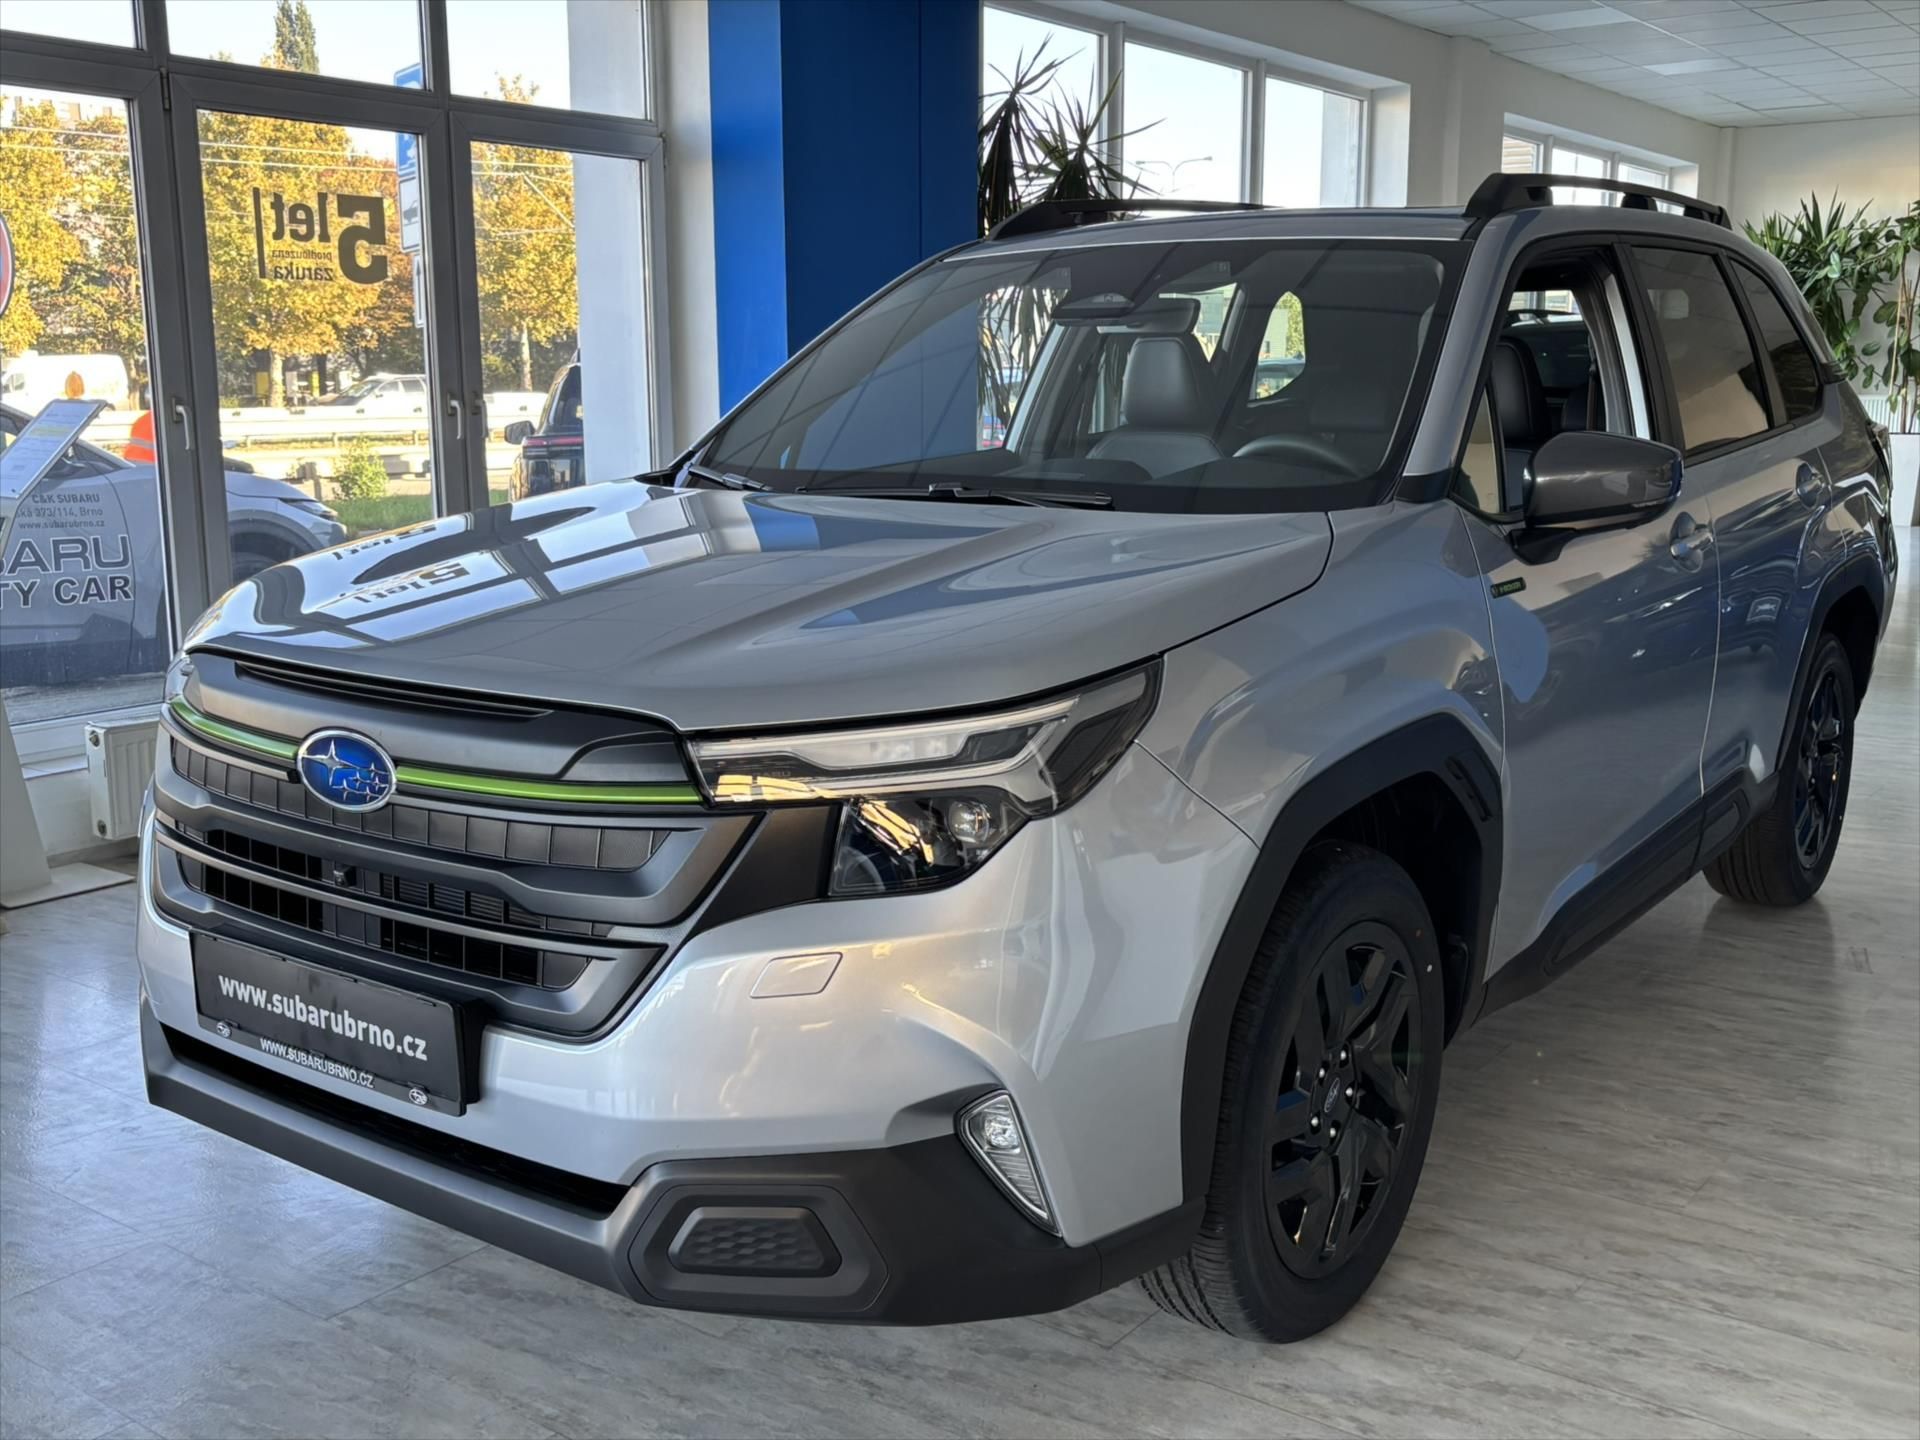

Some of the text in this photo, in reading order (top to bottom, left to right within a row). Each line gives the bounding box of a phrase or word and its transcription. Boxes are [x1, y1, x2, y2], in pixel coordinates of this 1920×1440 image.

[32, 494, 100, 504] C&K SUBARU
[79, 506, 103, 516] Brno
[53, 575, 133, 606] CAR
[218, 975, 428, 1062] www.subarubrno.cz
[260, 1038, 375, 1089] WWW.SUBARUBRNO.CZ
